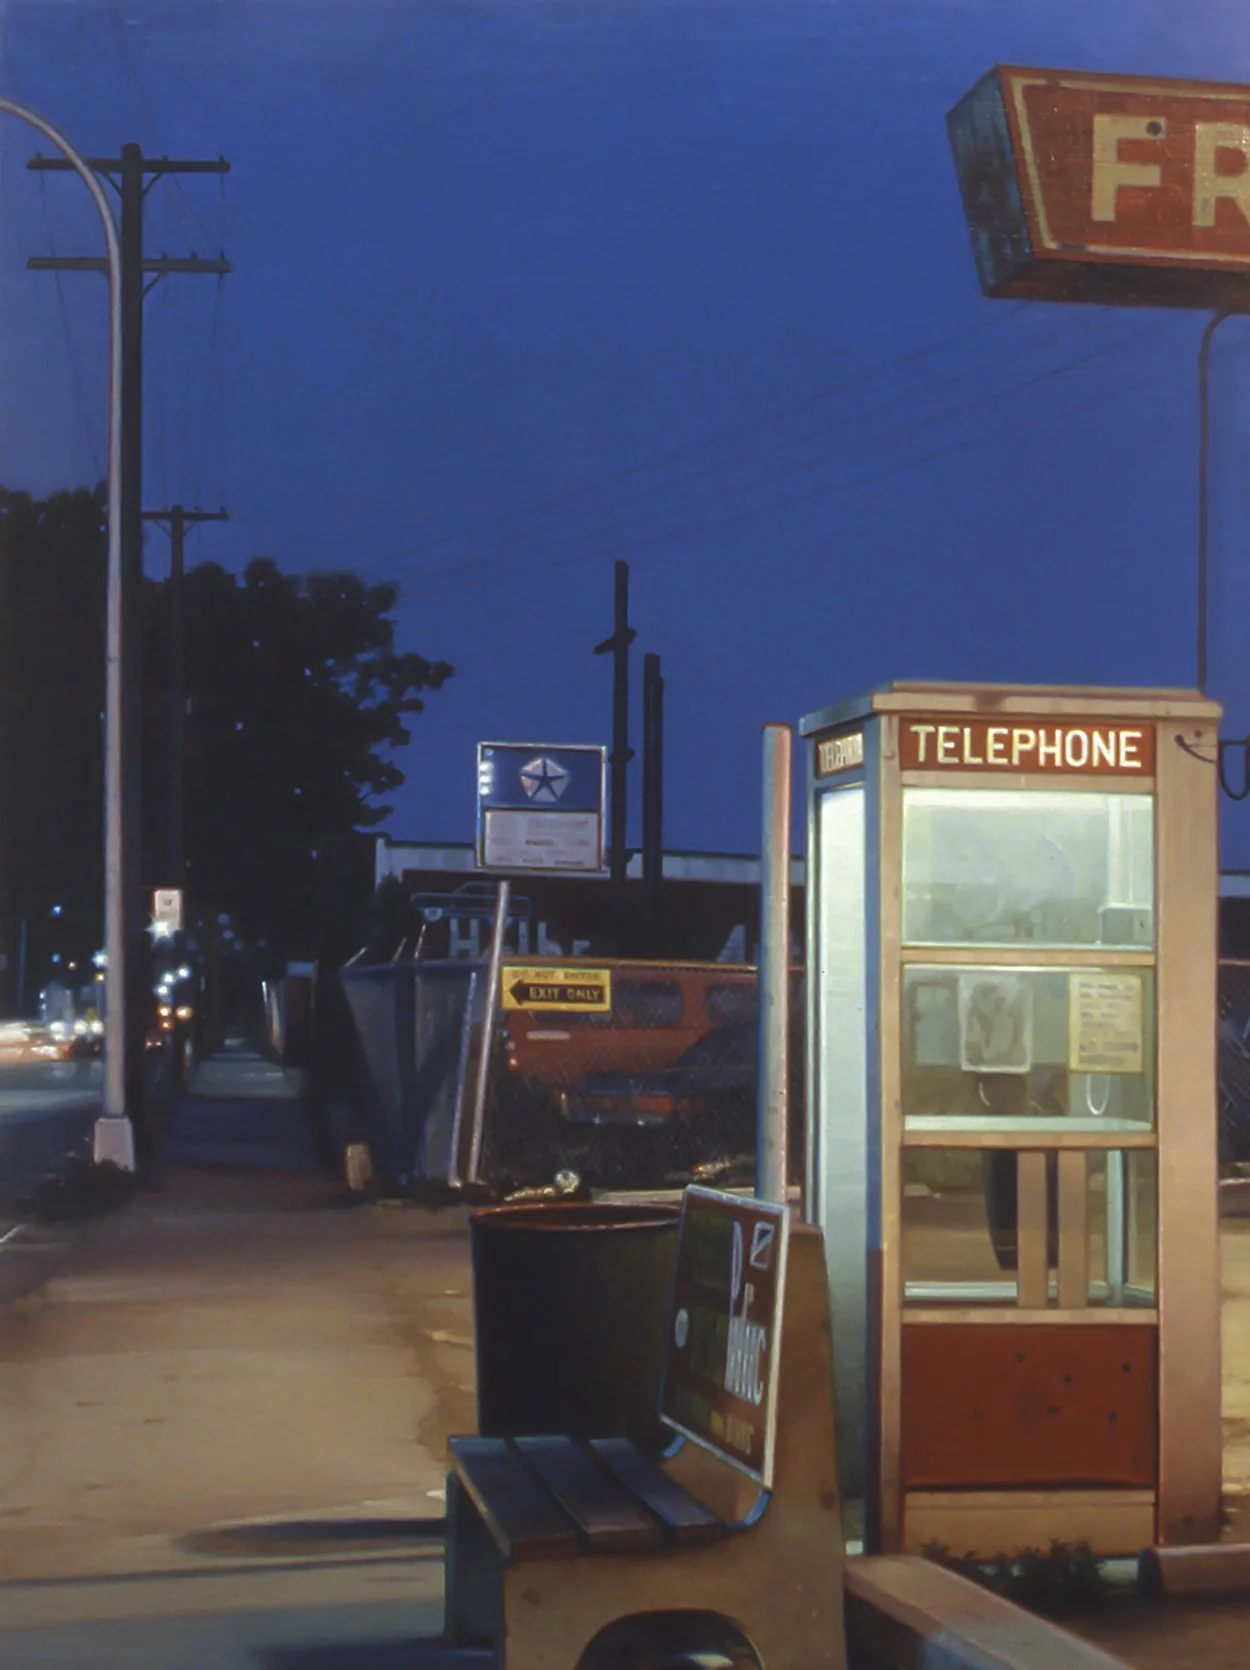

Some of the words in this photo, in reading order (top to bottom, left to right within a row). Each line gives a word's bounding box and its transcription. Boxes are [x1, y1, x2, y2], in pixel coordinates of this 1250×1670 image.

[910, 724, 1143, 768] TELEPHONE
[529, 986, 561, 1000] EXIT
[566, 987, 600, 1001] ONLY
